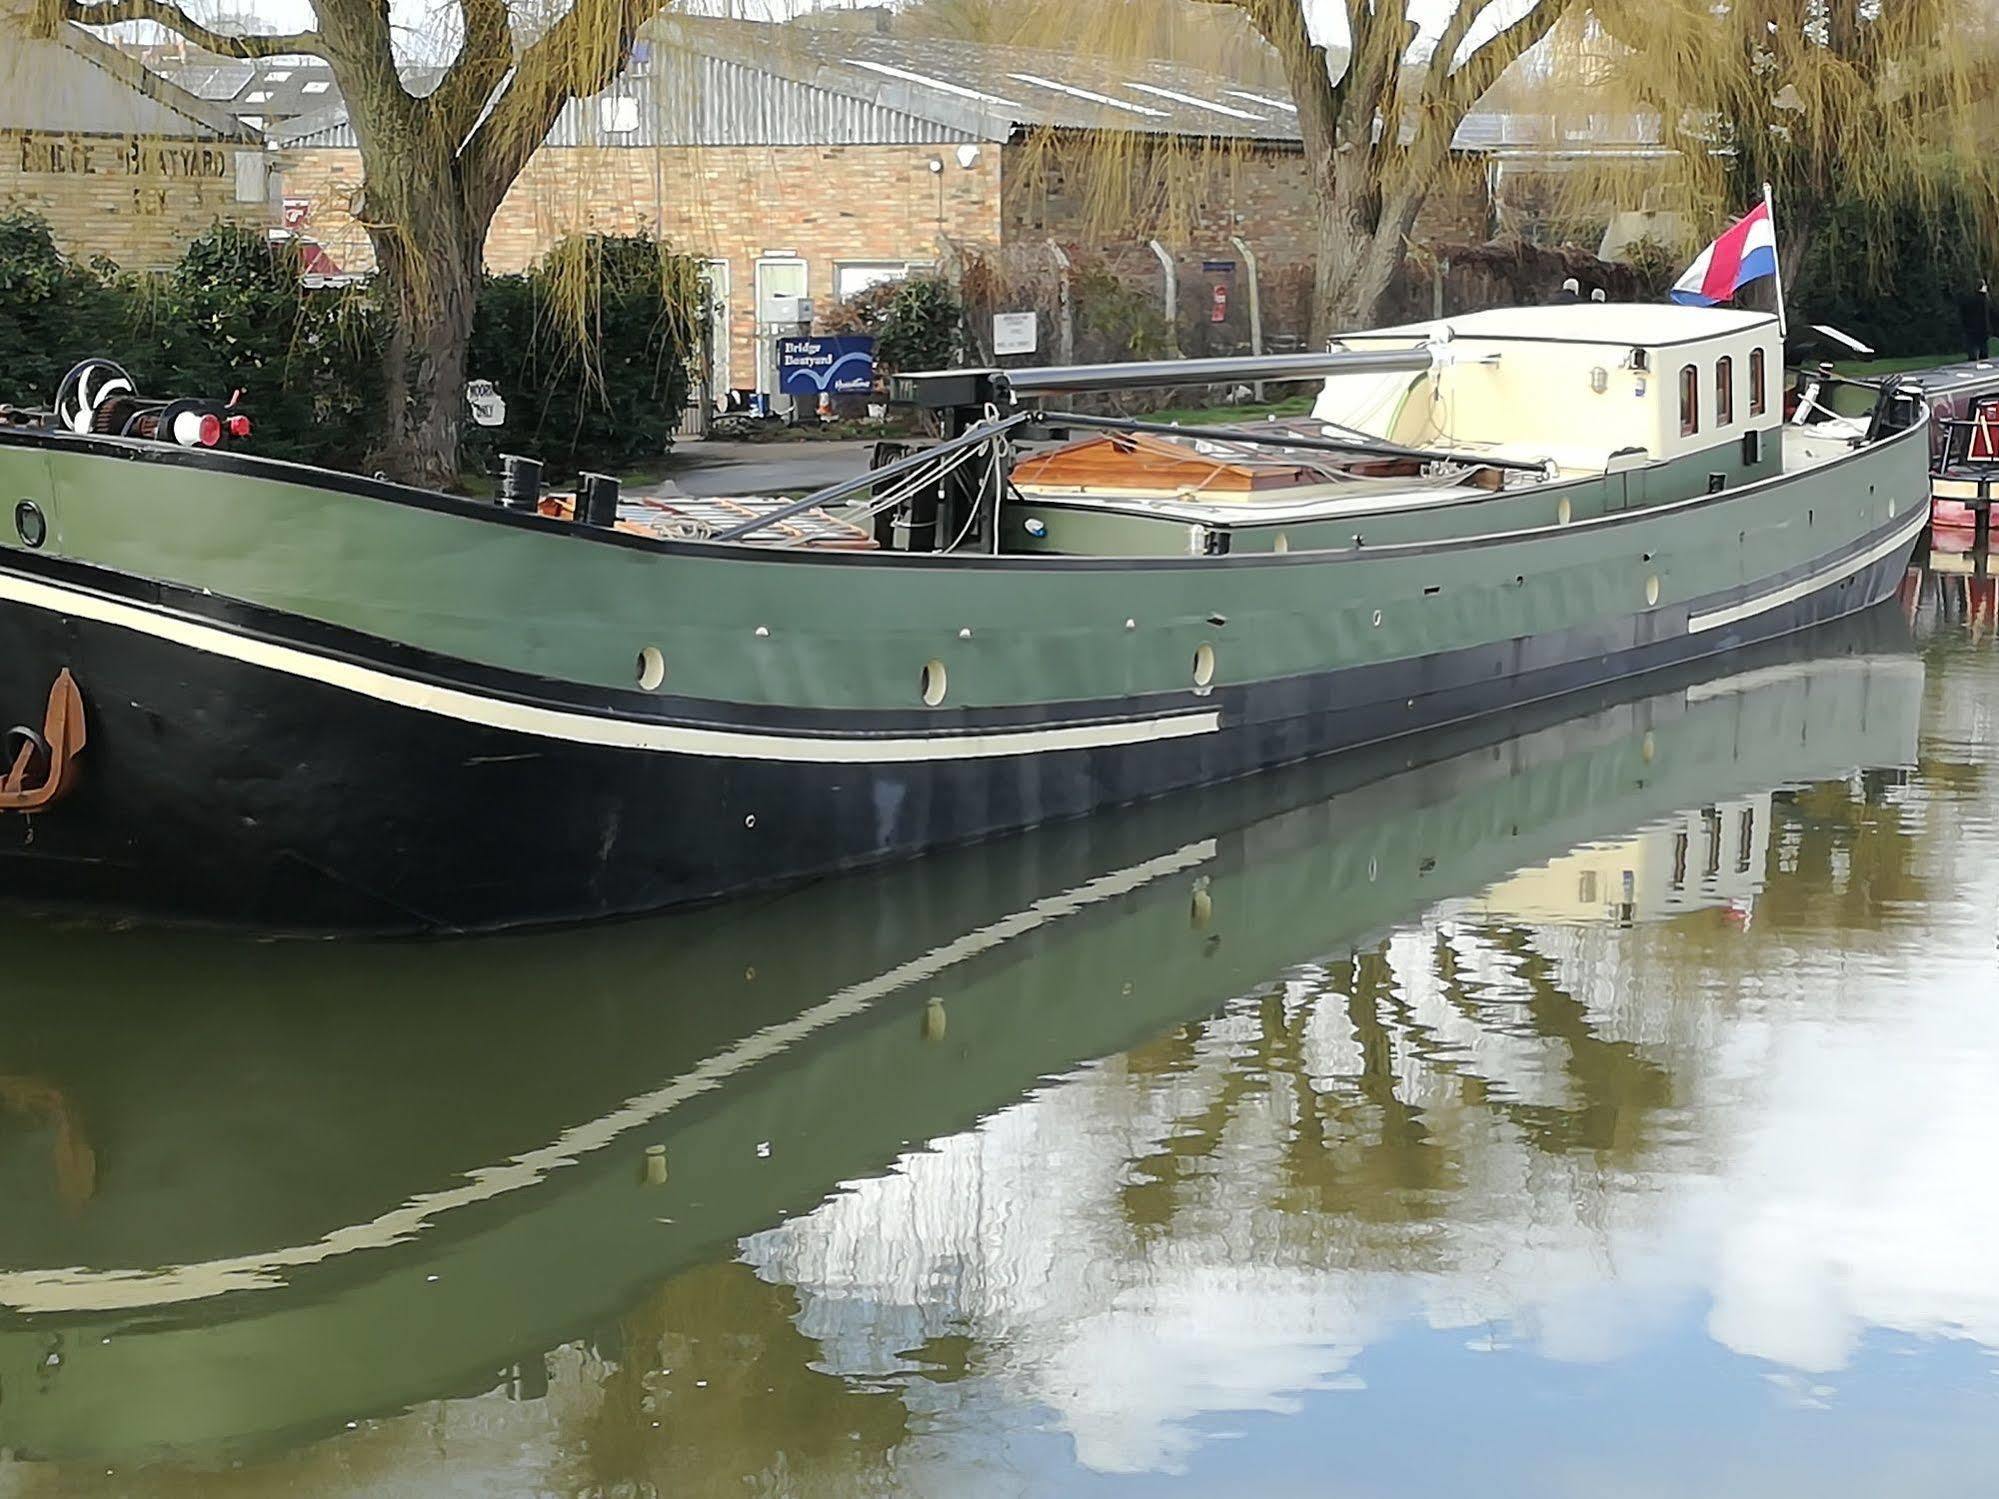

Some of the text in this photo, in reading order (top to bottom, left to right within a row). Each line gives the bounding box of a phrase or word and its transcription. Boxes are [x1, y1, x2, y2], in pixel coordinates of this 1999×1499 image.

[21, 137, 96, 174] BIDGE
[784, 342, 821, 355] Bridge
[784, 354, 833, 367] Boatyard
